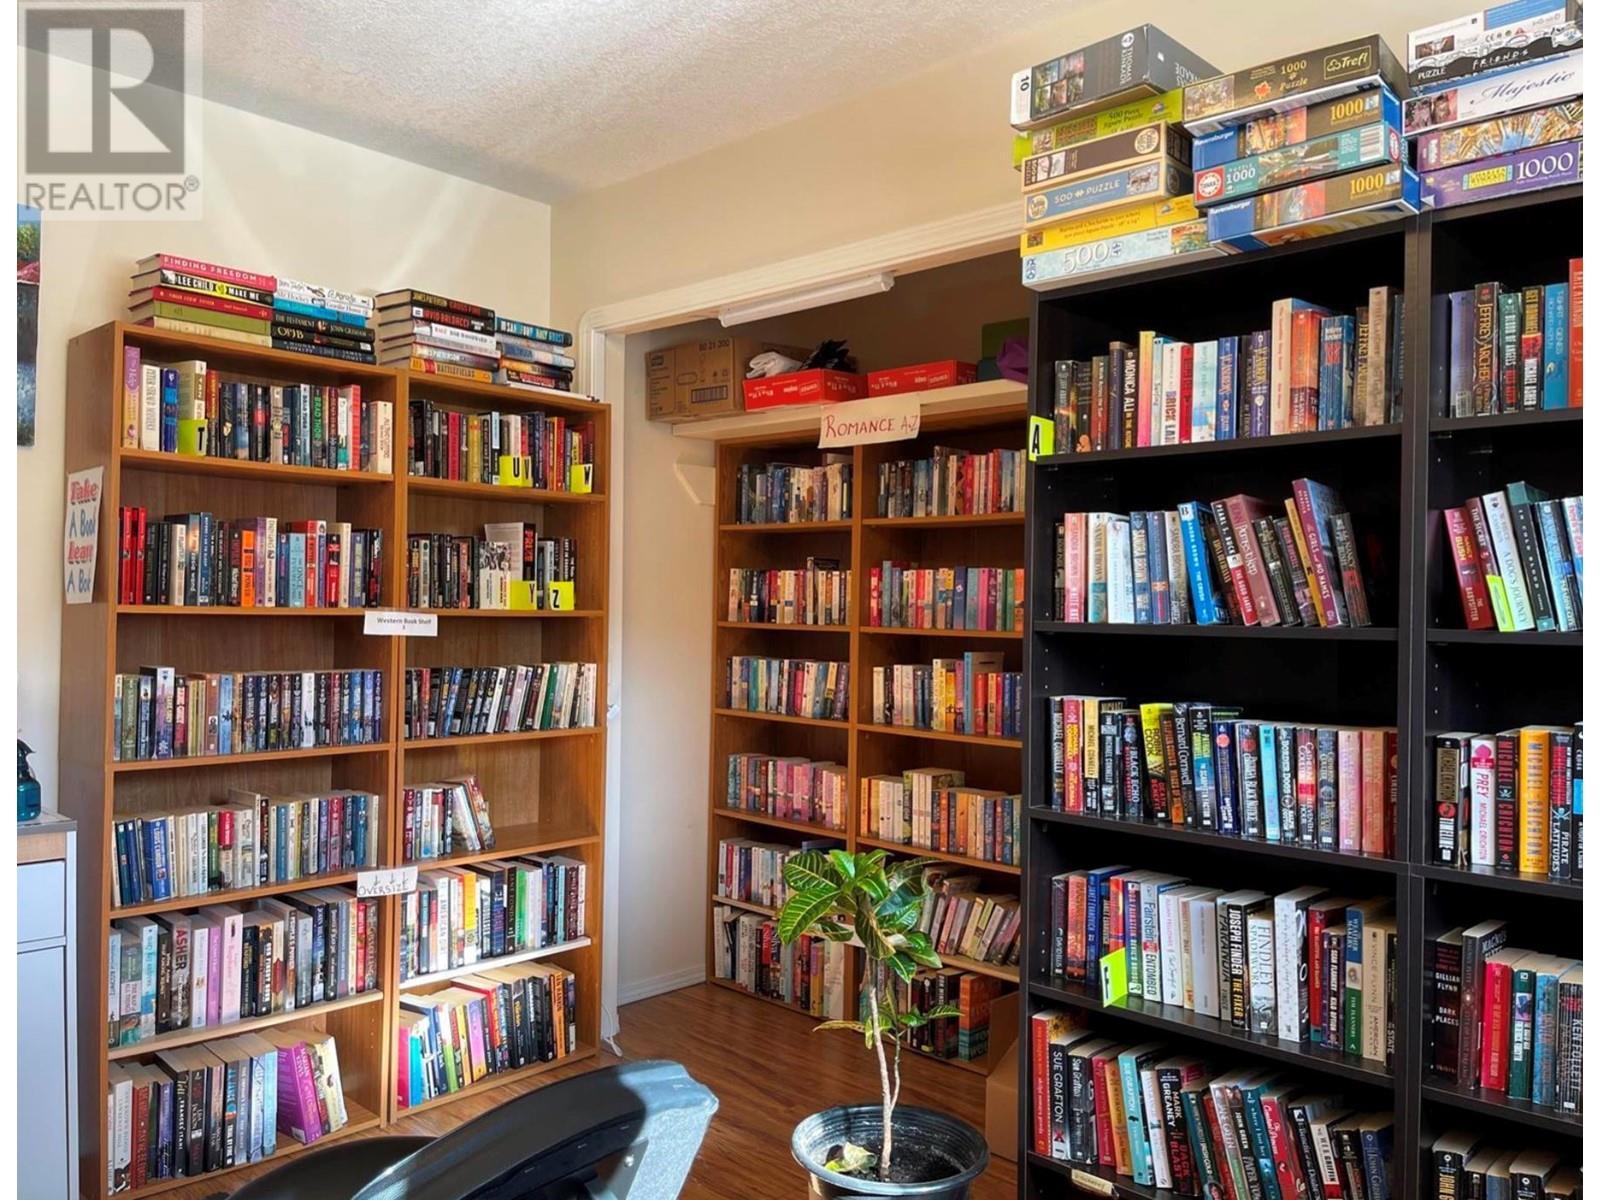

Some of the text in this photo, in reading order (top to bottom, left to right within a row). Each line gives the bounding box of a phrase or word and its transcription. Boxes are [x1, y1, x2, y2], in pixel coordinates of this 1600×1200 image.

[1280, 60, 1307, 74] 1000
[1339, 52, 1368, 68] Trefl
[1418, 67, 1446, 80] PUZZLE
[1279, 77, 1308, 91] Puzzle
[1481, 71, 1576, 102] Majestic
[1330, 98, 1363, 121] 1000
[1226, 167, 1256, 184] 1000
[1516, 152, 1574, 180] 1000
[1086, 179, 1121, 195] PUZZLE
[1350, 173, 1384, 194] 1000
[163, 256, 258, 282] FINDING FREEDOM
[1063, 243, 1110, 273] 500
[177, 275, 213, 291] LEE CHILD
[228, 286, 260, 301] MAKE ME
[1478, 303, 1493, 383] JEFFREY ARCHER
[1505, 345, 1516, 367] ANGELS
[1123, 359, 1137, 413] MONICA ALI
[1165, 391, 1177, 425] BRICK
[197, 426, 206, 451] T
[825, 415, 894, 438] ROMANCE
[1031, 424, 1040, 454] A
[70, 478, 98, 500] Take
[69, 510, 77, 538] A
[1216, 503, 1227, 529] PEARL
[1225, 535, 1235, 556] BUCK
[1455, 536, 1466, 561] BUSH
[1308, 532, 1318, 554] GIRLS
[1319, 579, 1330, 599] NAMES
[1511, 585, 1529, 625] JOURNEY
[404, 617, 417, 625] Book
[419, 617, 431, 625] Shelf
[1145, 728, 1154, 756] COOK
[1153, 727, 1162, 756] ROBIN
[1175, 717, 1192, 785] Bernard Cornwell
[1130, 749, 1138, 802] BLACK ECHO
[1498, 740, 1513, 851] MICHAEL CRICHTON
[1527, 743, 1543, 855] MICHAEL CRICHTON
[1476, 772, 1489, 860] PREY MICHAEL CRICHTON
[1439, 817, 1454, 849] TIMELINE
[1552, 823, 1561, 872] LATITUDES
[1561, 831, 1569, 864] PIRATE
[358, 880, 410, 896] OVERSIZE
[175, 927, 188, 972] ASHER
[1144, 901, 1157, 996] Fairstein ENTOMBED
[1257, 926, 1273, 987] FINDLEY
[1229, 908, 1244, 1018] JOSEPH FINDER THE FIXER
[1435, 972, 1461, 983] GILLIAN
[1437, 983, 1458, 993] FLYNN
[1435, 1015, 1460, 1026] PLACES
[1438, 1006, 1456, 1016] DARK
[1387, 1030, 1395, 1054] STATE
[1570, 1019, 1583, 1091] KEN FOLLETT
[1053, 1051, 1064, 1124] SUE GRAFTON
[1072, 1058, 1081, 1098] Sue Grafton
[1162, 1083, 1176, 1127] GREANEY
[1172, 1091, 1182, 1119] MARK
[1235, 1111, 1244, 1129] JOHN
[1239, 1129, 1249, 1149] GREEN
